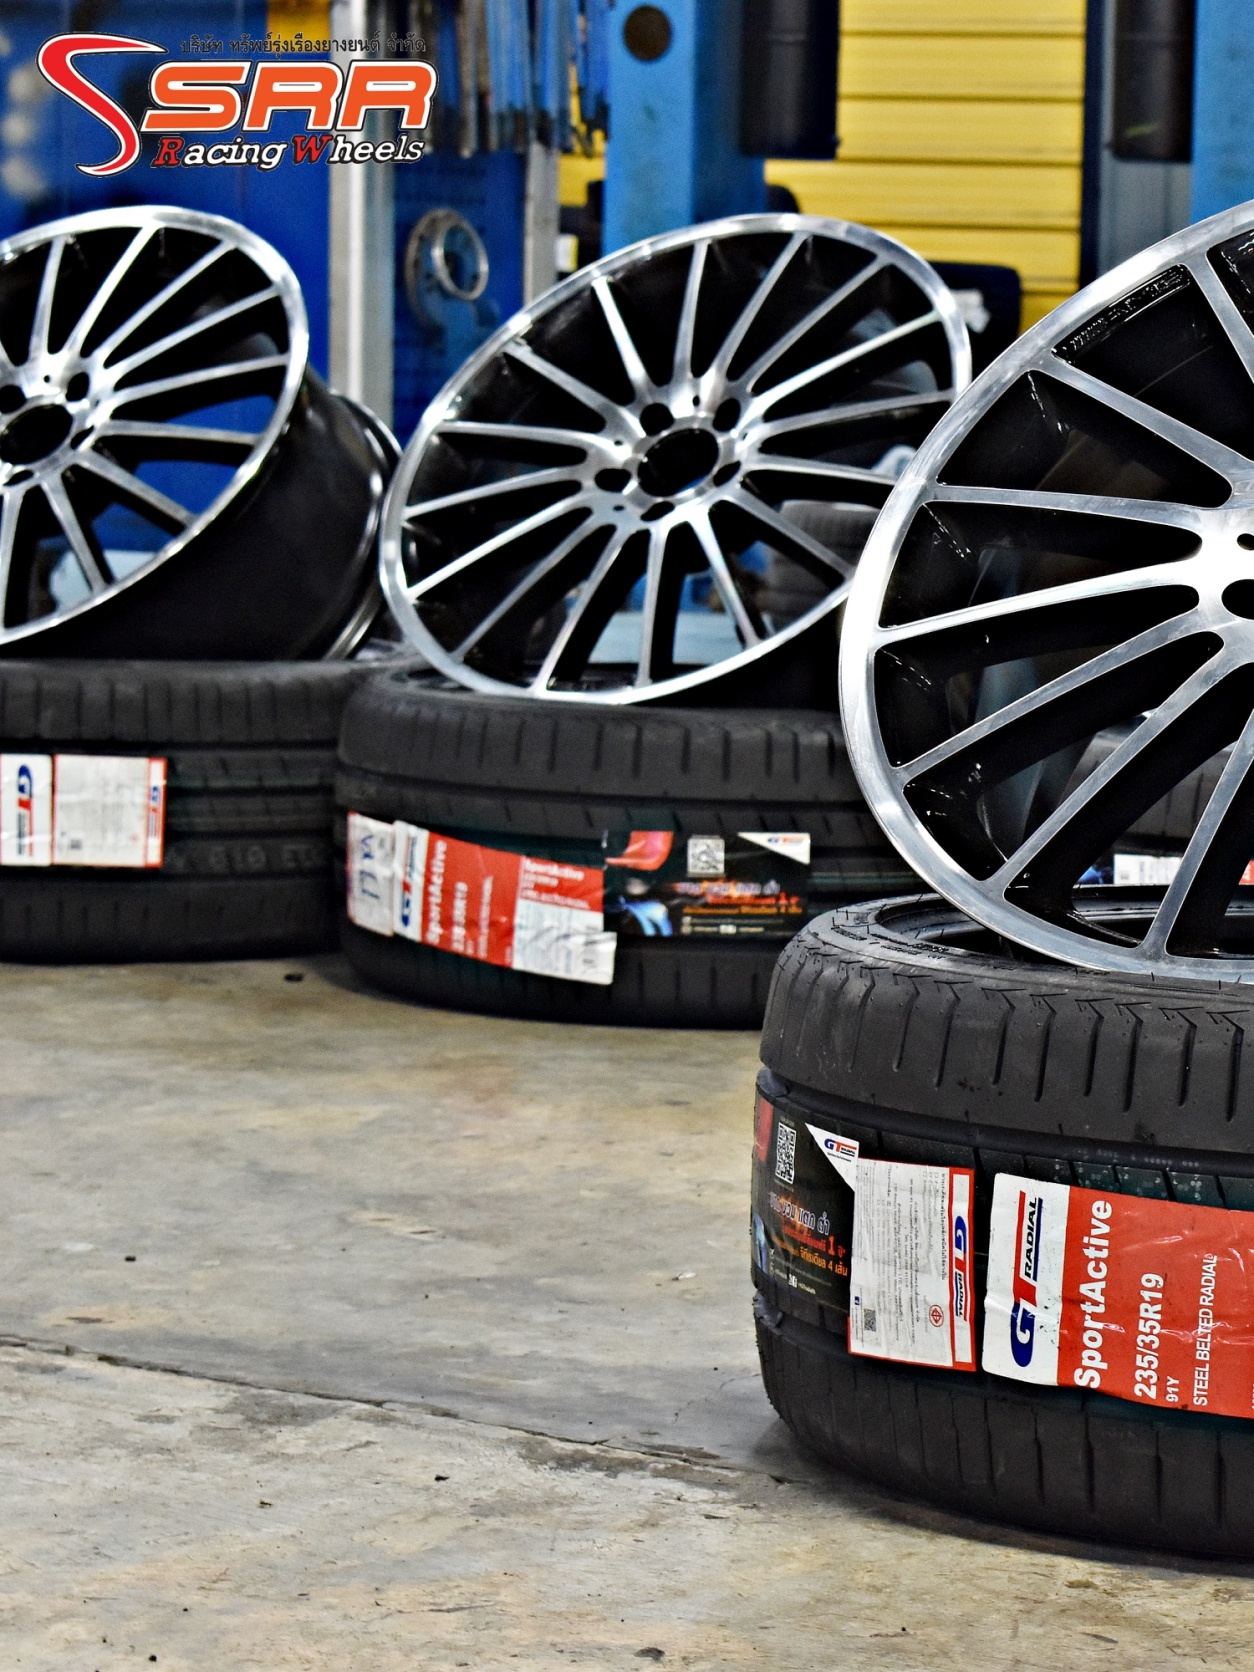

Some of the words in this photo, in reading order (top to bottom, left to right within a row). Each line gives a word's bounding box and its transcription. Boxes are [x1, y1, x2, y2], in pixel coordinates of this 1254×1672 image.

[1024, 1197, 1037, 1279] RADIAL
[957, 1272, 965, 1317] RADIAL
[1074, 1200, 1112, 1389] SportActive
[1200, 1255, 1218, 1306] RADIAL
[1134, 1273, 1164, 1400] 235/35R19
[1196, 1308, 1213, 1360] BELTED
[1166, 1376, 1180, 1402] 91Y
[1193, 1363, 1210, 1406] STEEL
